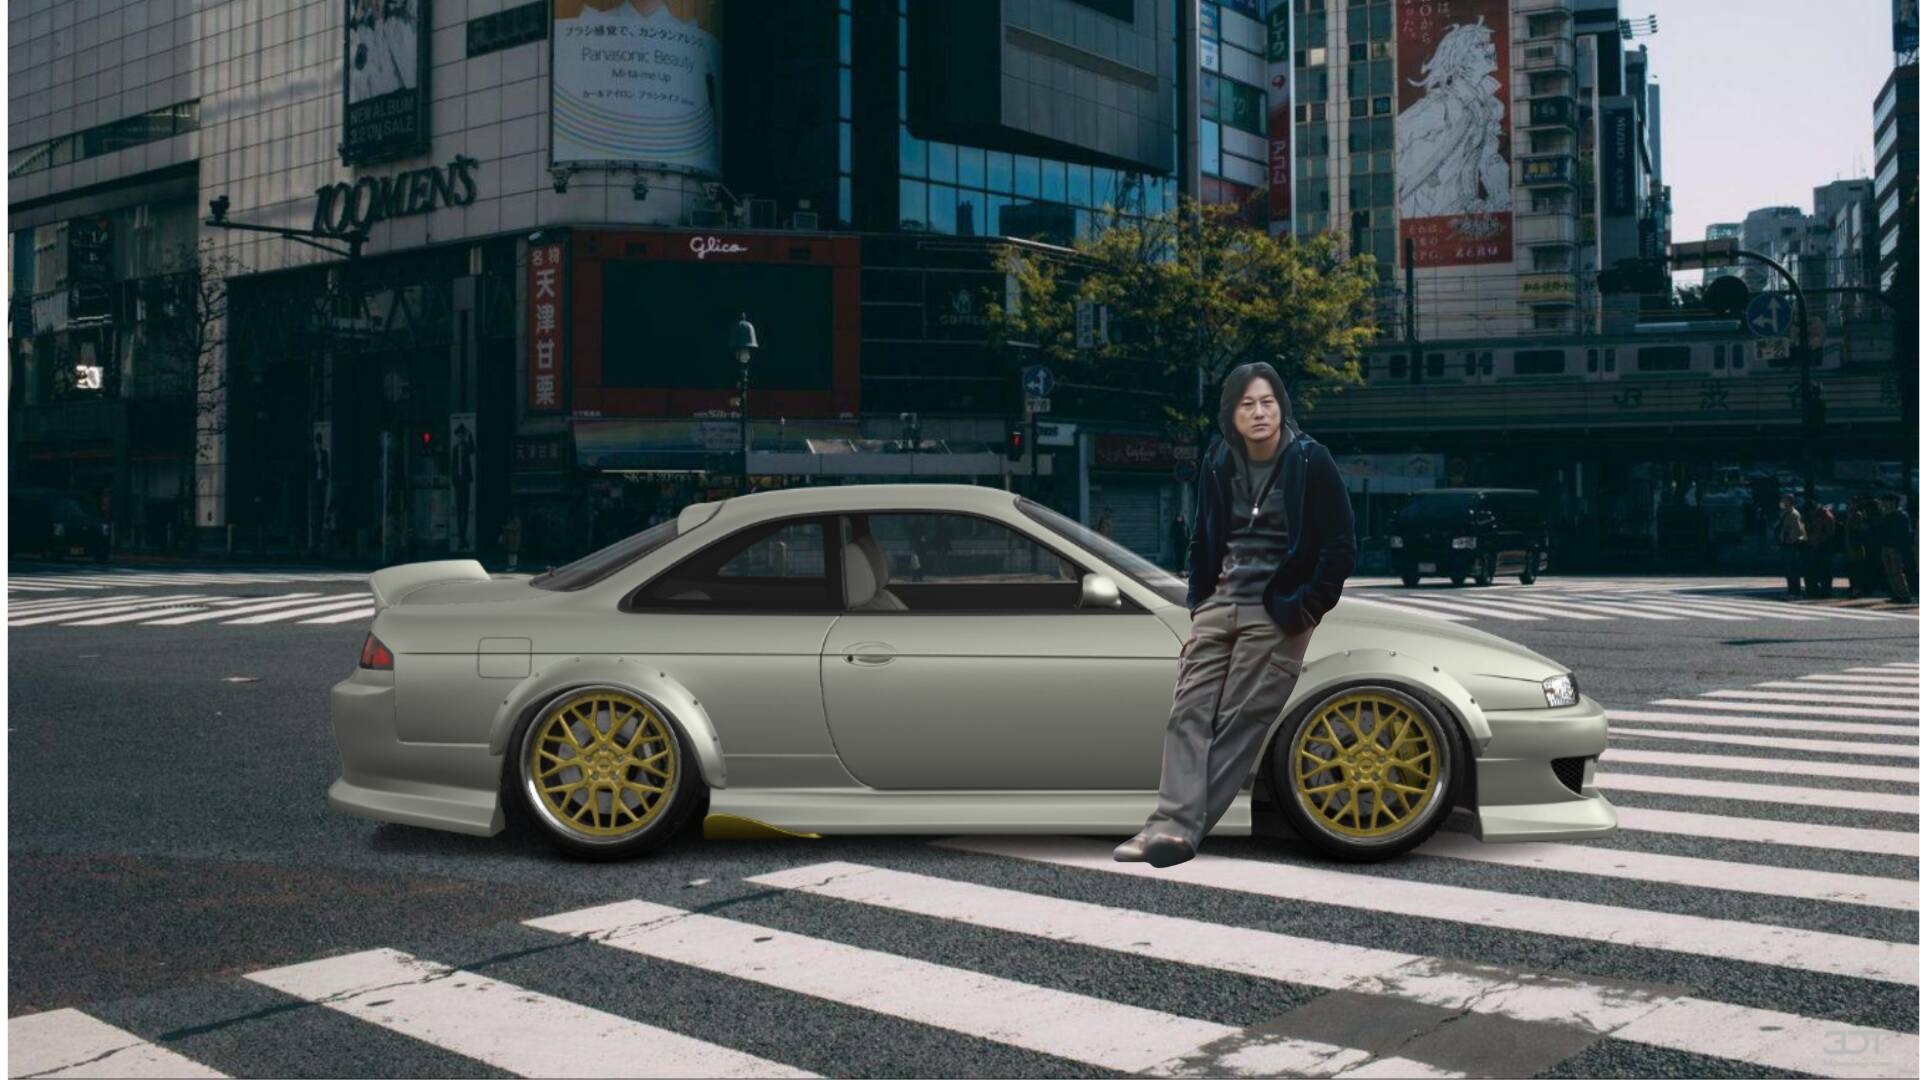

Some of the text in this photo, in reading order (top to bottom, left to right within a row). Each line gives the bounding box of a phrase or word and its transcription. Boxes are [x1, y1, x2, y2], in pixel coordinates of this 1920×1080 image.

[582, 46, 697, 73] Panasonic Beauty
[658, 71, 672, 83] Up
[350, 96, 414, 125] NEW ALBUM
[384, 114, 414, 136] SALE
[1272, 140, 1287, 184] アコム
[689, 236, 749, 259] Glico
[535, 268, 556, 406] 天津甘栗
[1613, 387, 1643, 409] JR
